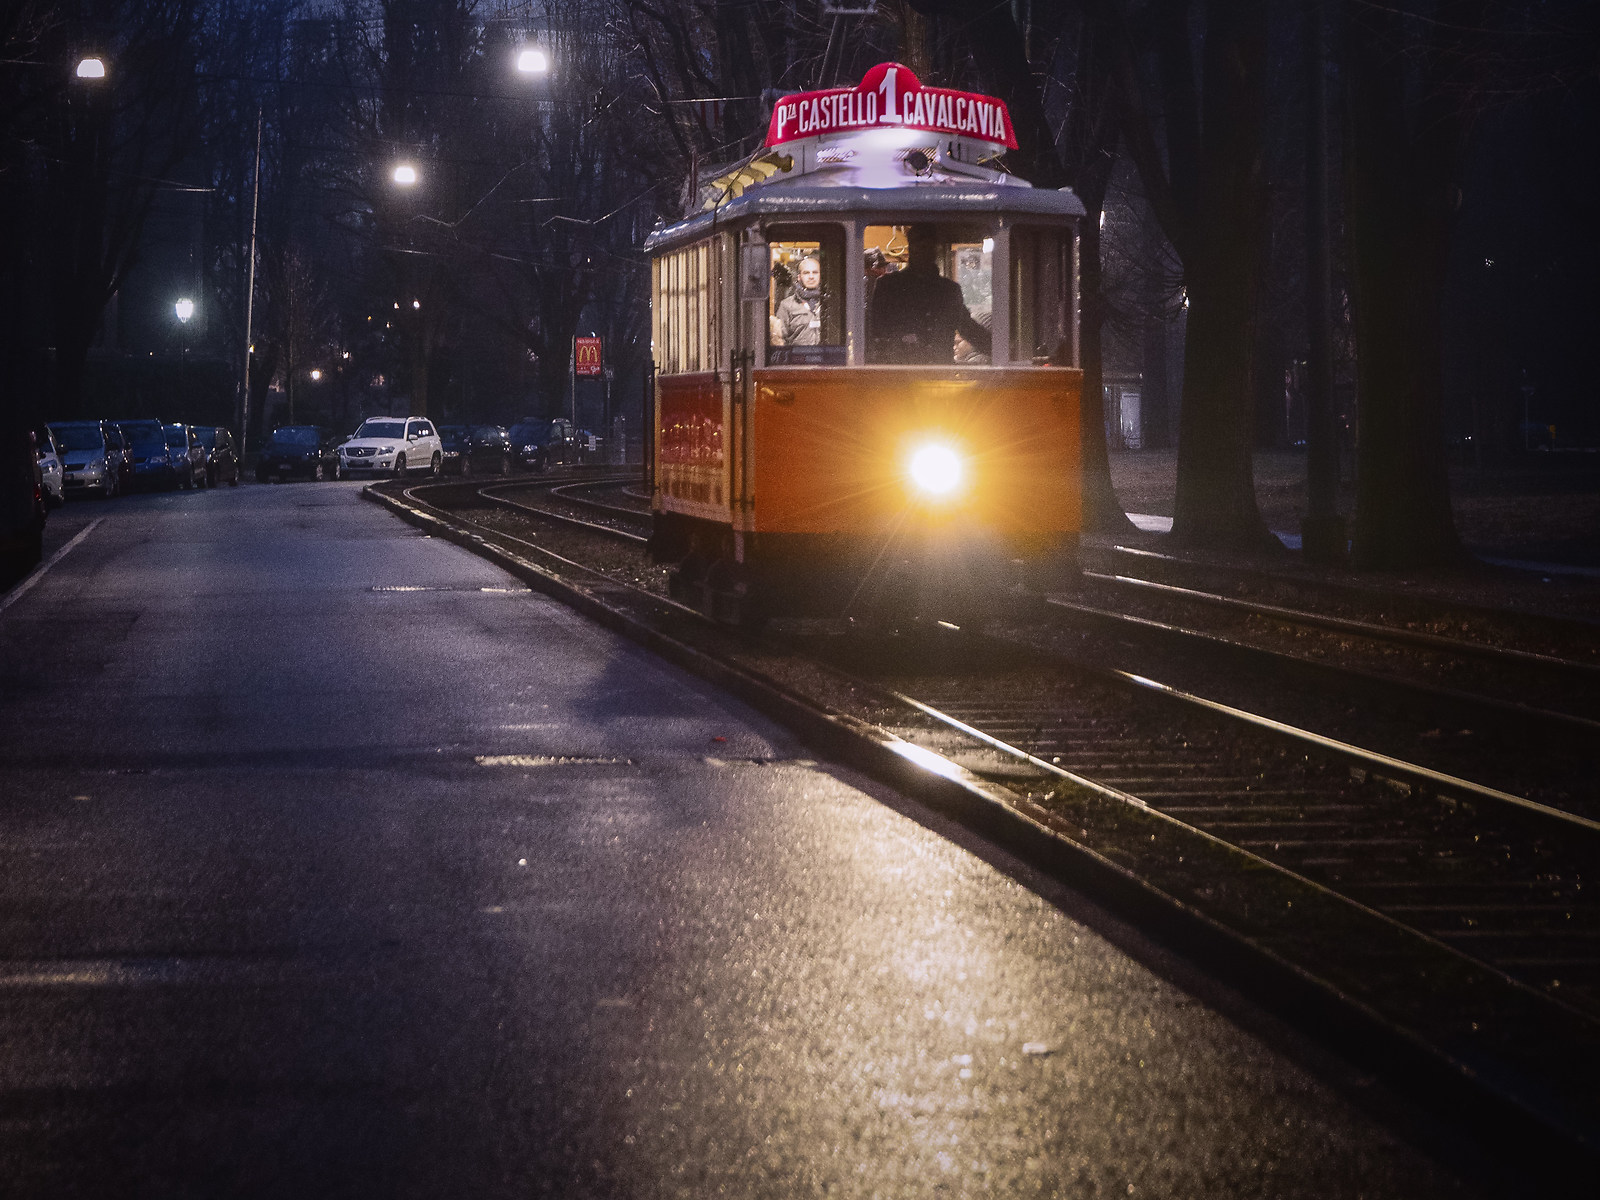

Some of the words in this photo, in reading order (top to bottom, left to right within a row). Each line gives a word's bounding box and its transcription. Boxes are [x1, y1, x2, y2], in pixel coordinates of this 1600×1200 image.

[799, 91, 877, 133] CASTELLO
[879, 67, 903, 124] 1
[903, 91, 1006, 141] CAVALCAVIA
